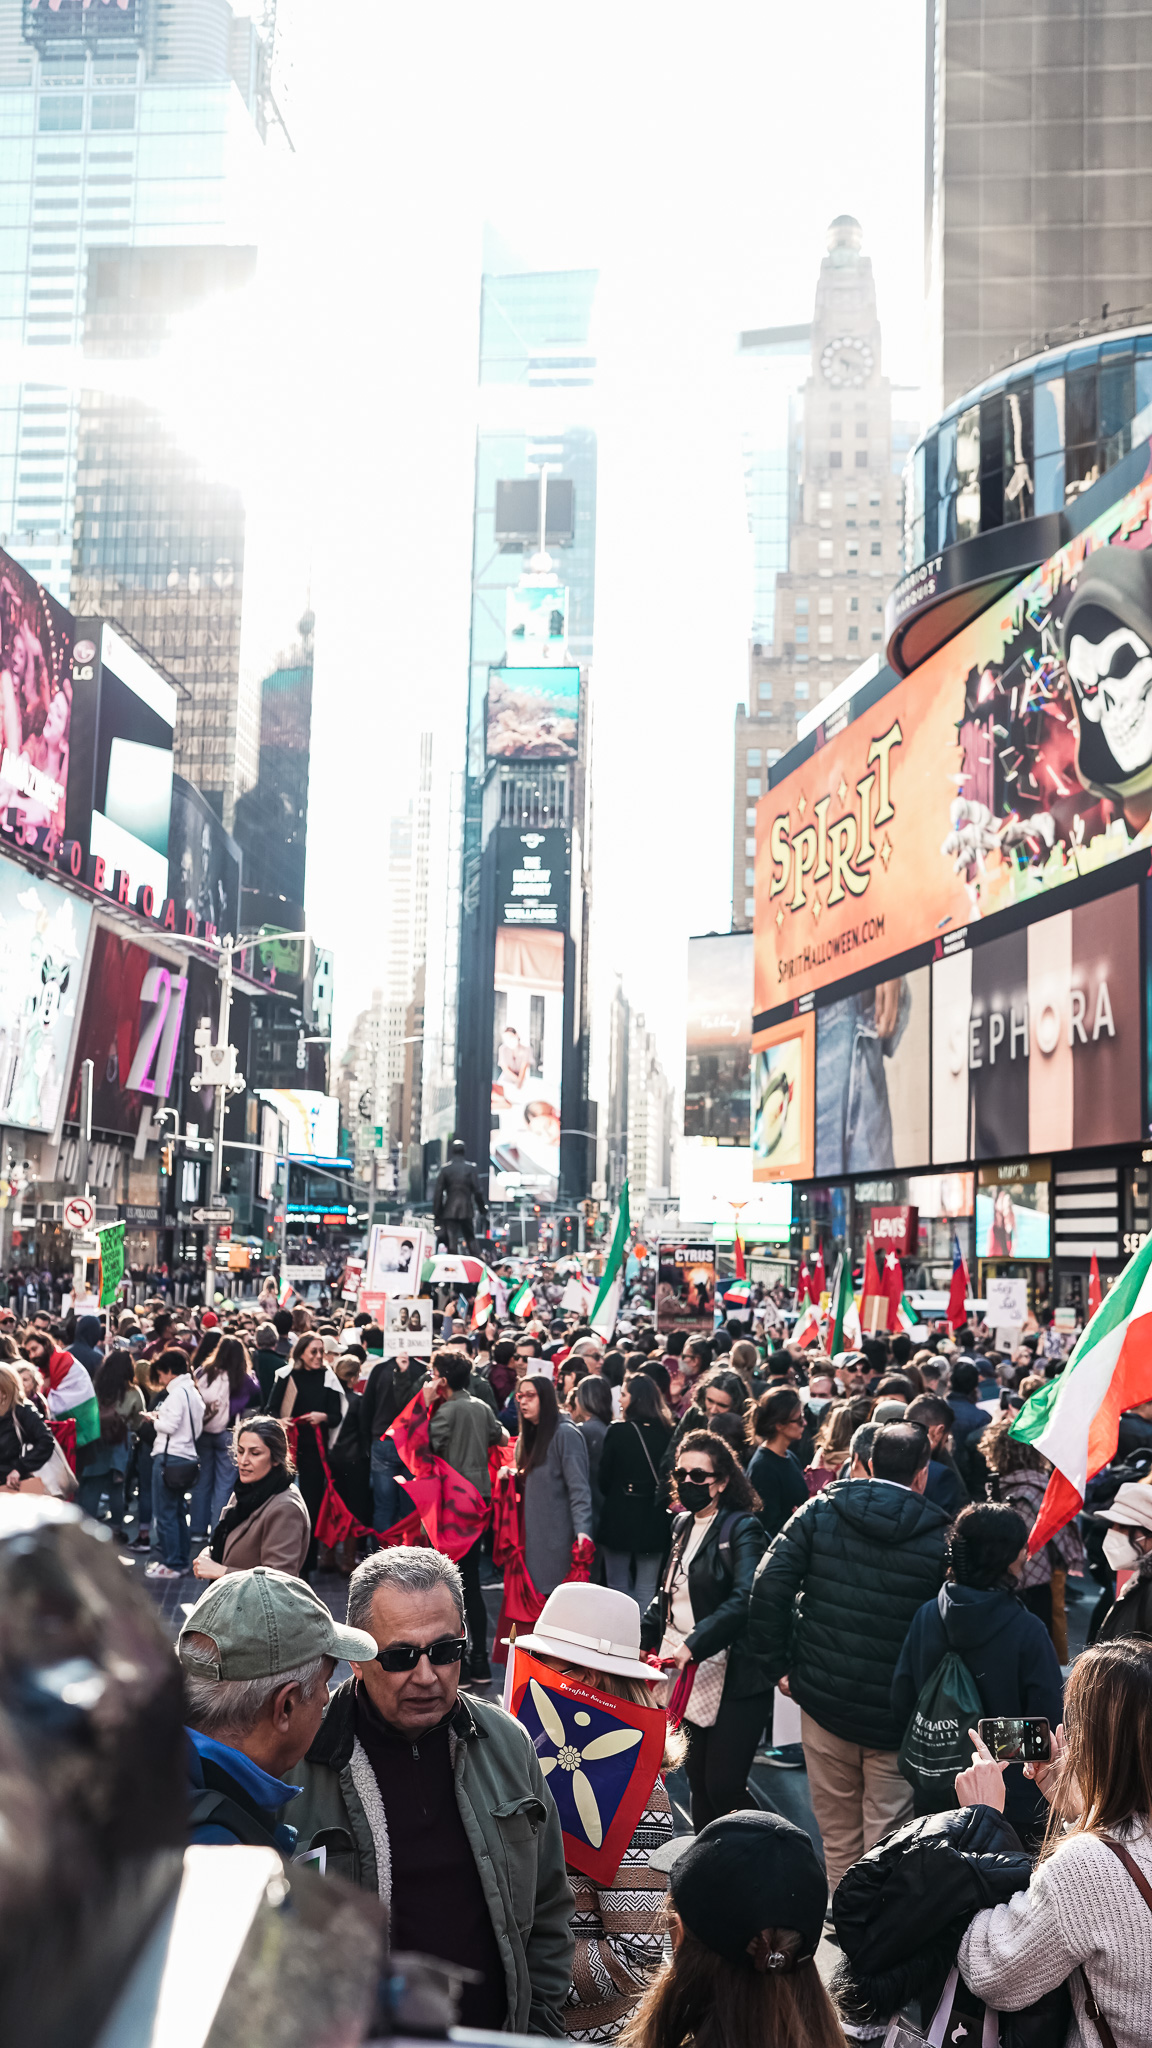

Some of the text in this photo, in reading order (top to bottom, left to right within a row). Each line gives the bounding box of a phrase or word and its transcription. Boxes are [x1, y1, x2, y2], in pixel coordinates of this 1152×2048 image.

[72, 665, 93, 680] LG
[770, 719, 903, 913] SPIRIT
[126, 966, 188, 1097] 21
[674, 1249, 714, 1262] CYRUS
[560, 1682, 590, 1697] Derafshe
